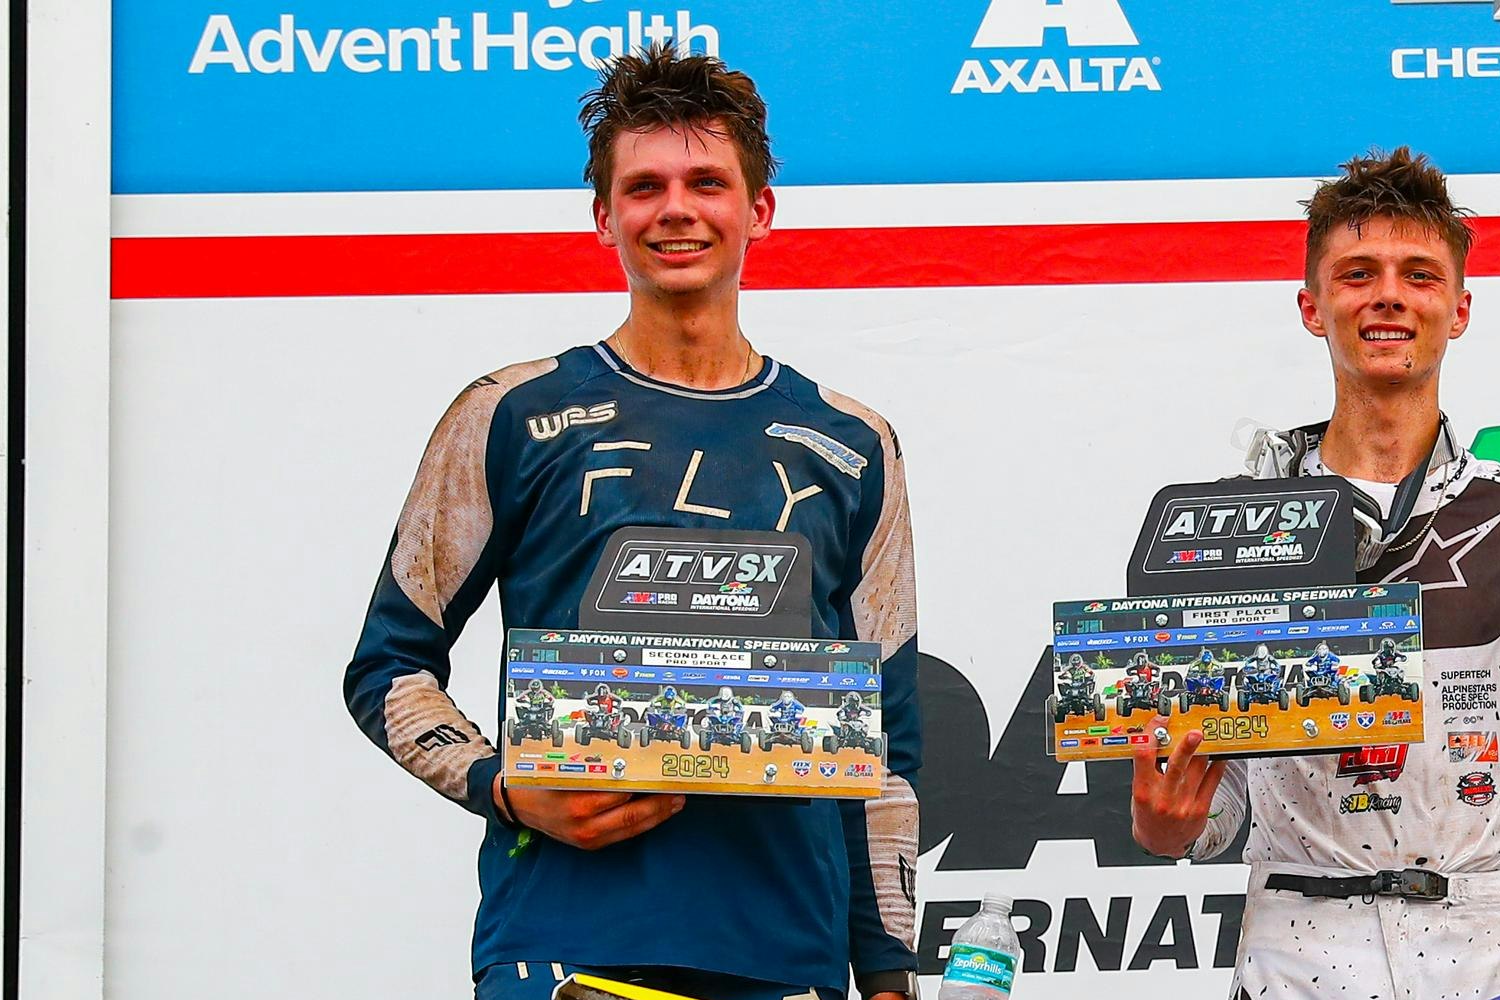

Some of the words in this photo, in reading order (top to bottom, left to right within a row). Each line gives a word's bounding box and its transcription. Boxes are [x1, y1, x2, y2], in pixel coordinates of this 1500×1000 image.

[951, 57, 1161, 94] AXALTA
[528, 400, 618, 440] WPS
[579, 440, 824, 533] FLY
[1204, 549, 1222, 557] PRO
[1236, 544, 1303, 559] DAYTONA
[658, 593, 677, 601] PRO
[691, 594, 760, 606] DAYTONA
[1112, 600, 1169, 611] DAYTONA
[1171, 593, 1279, 607] INTERNATIONAL
[1283, 588, 1357, 601] SPEEDWAY
[1192, 611, 1229, 619] FIRST
[1236, 608, 1280, 616] PLACE
[569, 633, 627, 645] DAYTONA
[630, 636, 740, 649] INTERNATIONAL
[744, 640, 819, 652] SPEEDWAY
[648, 651, 698, 659] SECOND
[706, 653, 745, 661] PLACE
[1441, 670, 1491, 679] SUPERTECH
[1442, 684, 1497, 694] ALPINESTARS
[1442, 694, 1467, 702] RACE
[1468, 693, 1489, 701] SPEC
[1442, 701, 1497, 710] PRODUCTION
[1202, 715, 1269, 740] 2024
[661, 754, 730, 779] 2024
[954, 957, 1002, 975] Zephyrhills
